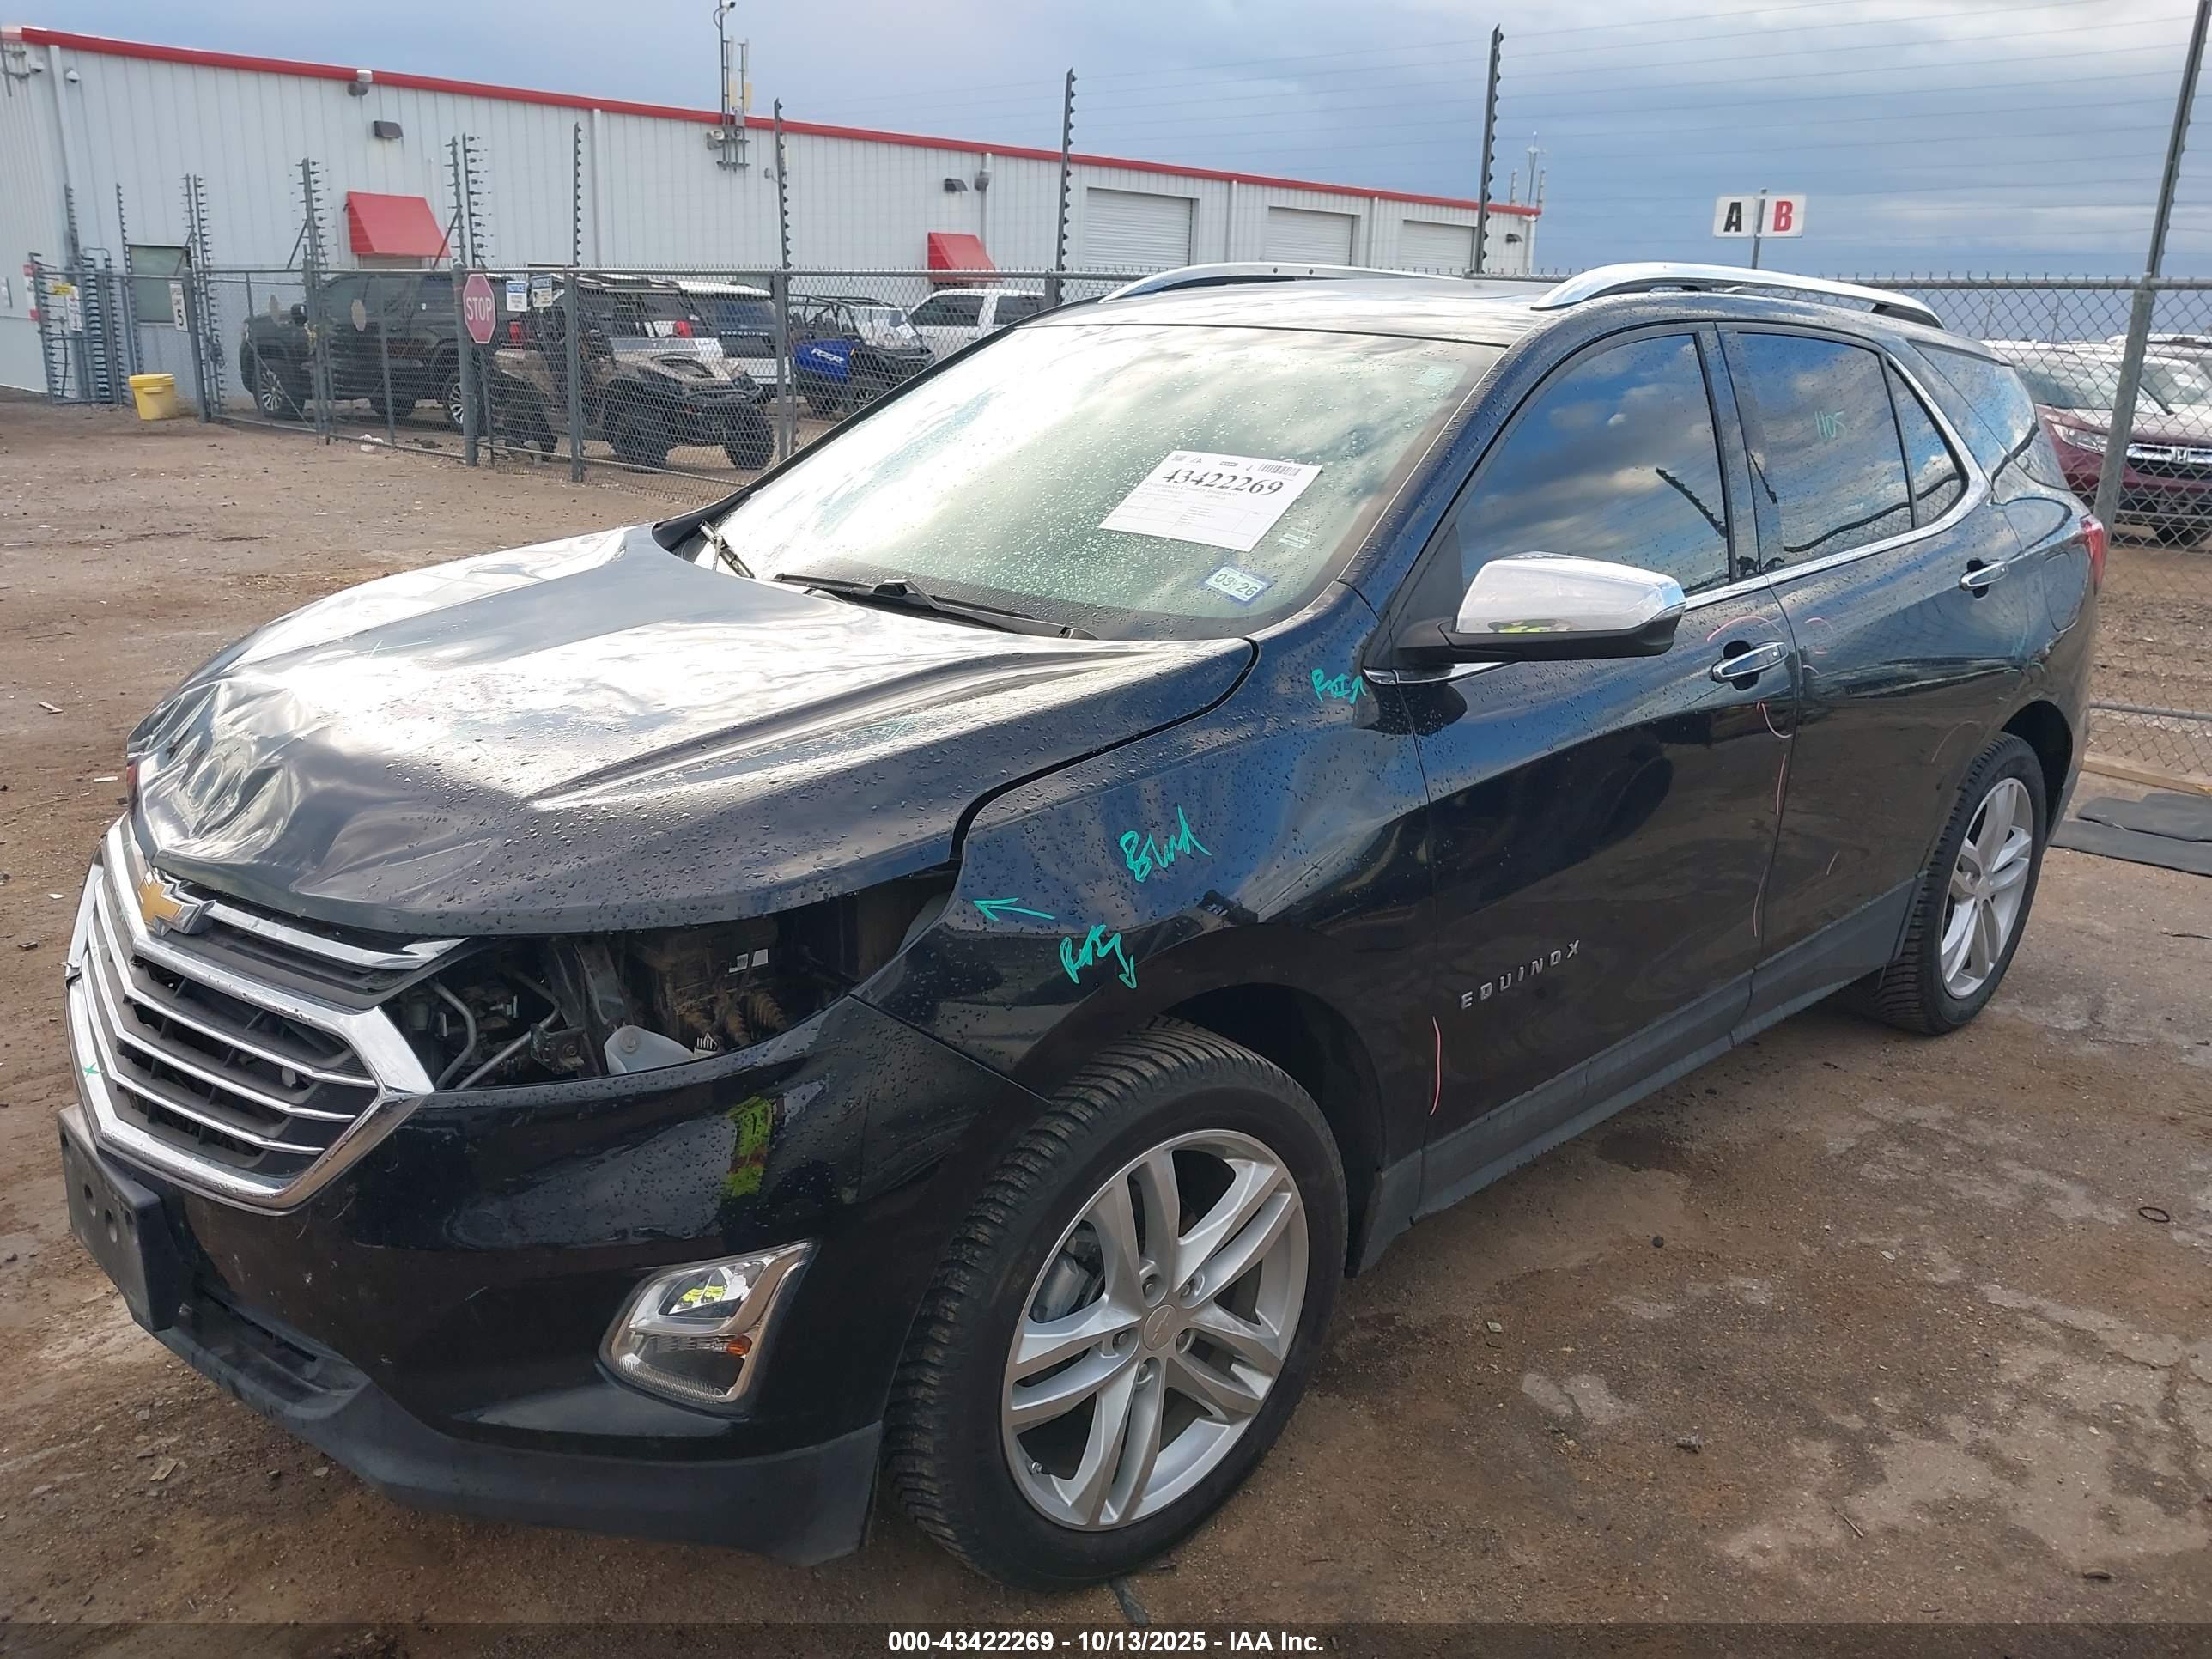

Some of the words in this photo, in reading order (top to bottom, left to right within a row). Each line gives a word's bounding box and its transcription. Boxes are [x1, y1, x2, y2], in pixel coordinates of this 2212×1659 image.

[1723, 201, 1741, 233] A
[1772, 200, 1793, 232] B
[177, 308, 185, 326] 5
[466, 296, 492, 322] STOP
[1162, 468, 1284, 495] 43422269
[1461, 939, 1580, 1010] EQUINOX
